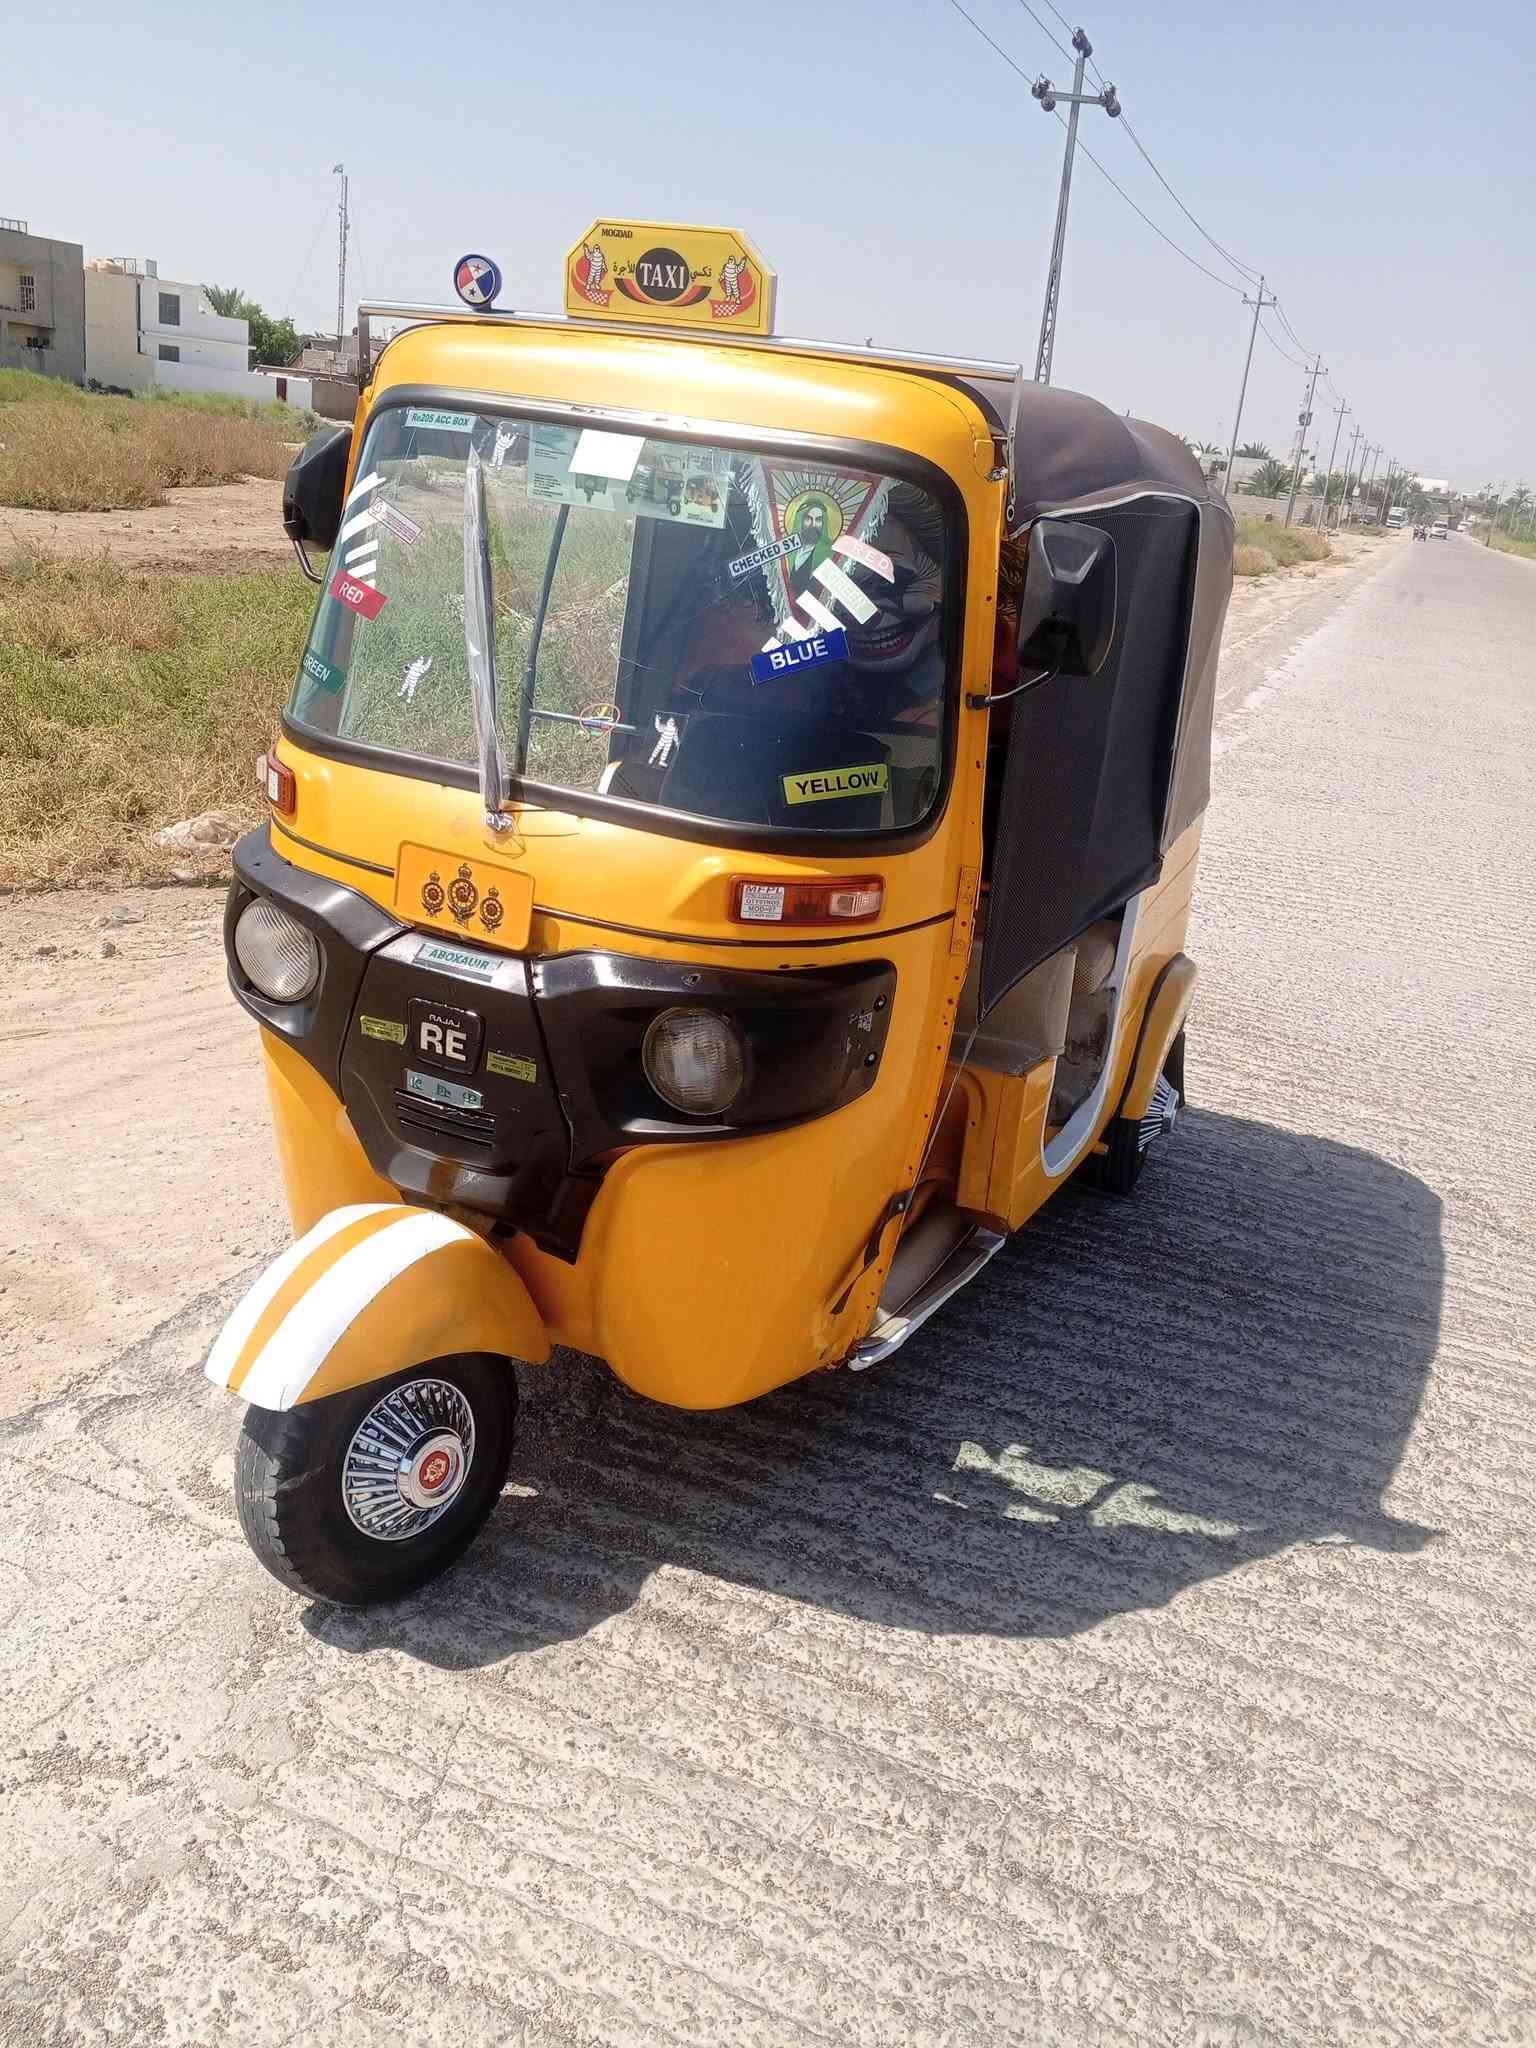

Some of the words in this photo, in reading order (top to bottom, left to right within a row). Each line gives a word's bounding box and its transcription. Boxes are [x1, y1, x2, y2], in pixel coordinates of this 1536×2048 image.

[640, 262, 685, 289] TAXI
[732, 543, 781, 573] CHECKED
[338, 581, 365, 604] RED
[302, 653, 331, 682] GREEN
[769, 638, 828, 670] BLUE
[795, 770, 879, 795] YELLOW
[420, 1021, 467, 1062] RE
